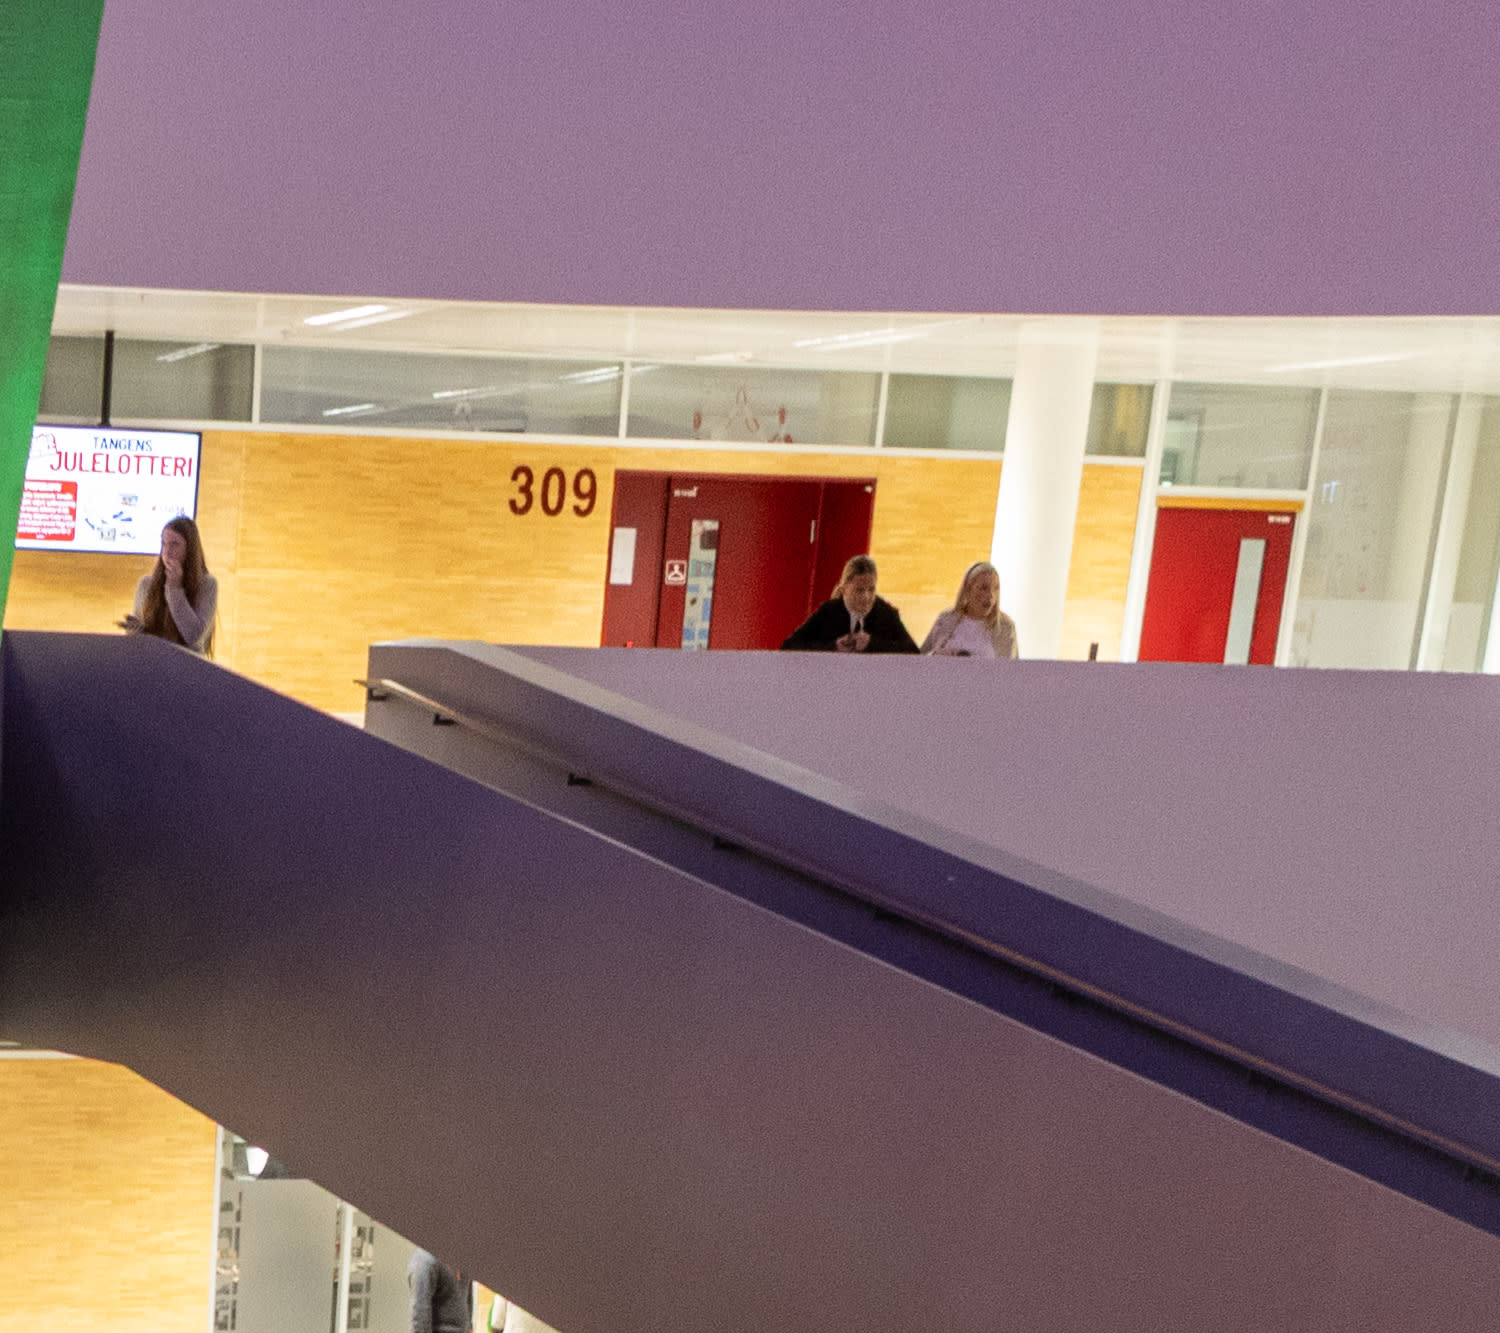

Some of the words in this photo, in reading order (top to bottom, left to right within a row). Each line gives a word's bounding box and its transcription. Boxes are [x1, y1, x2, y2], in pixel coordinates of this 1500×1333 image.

[93, 437, 153, 451] TANGENS
[49, 451, 193, 477] JULELOTTERI
[508, 464, 598, 518] 309
